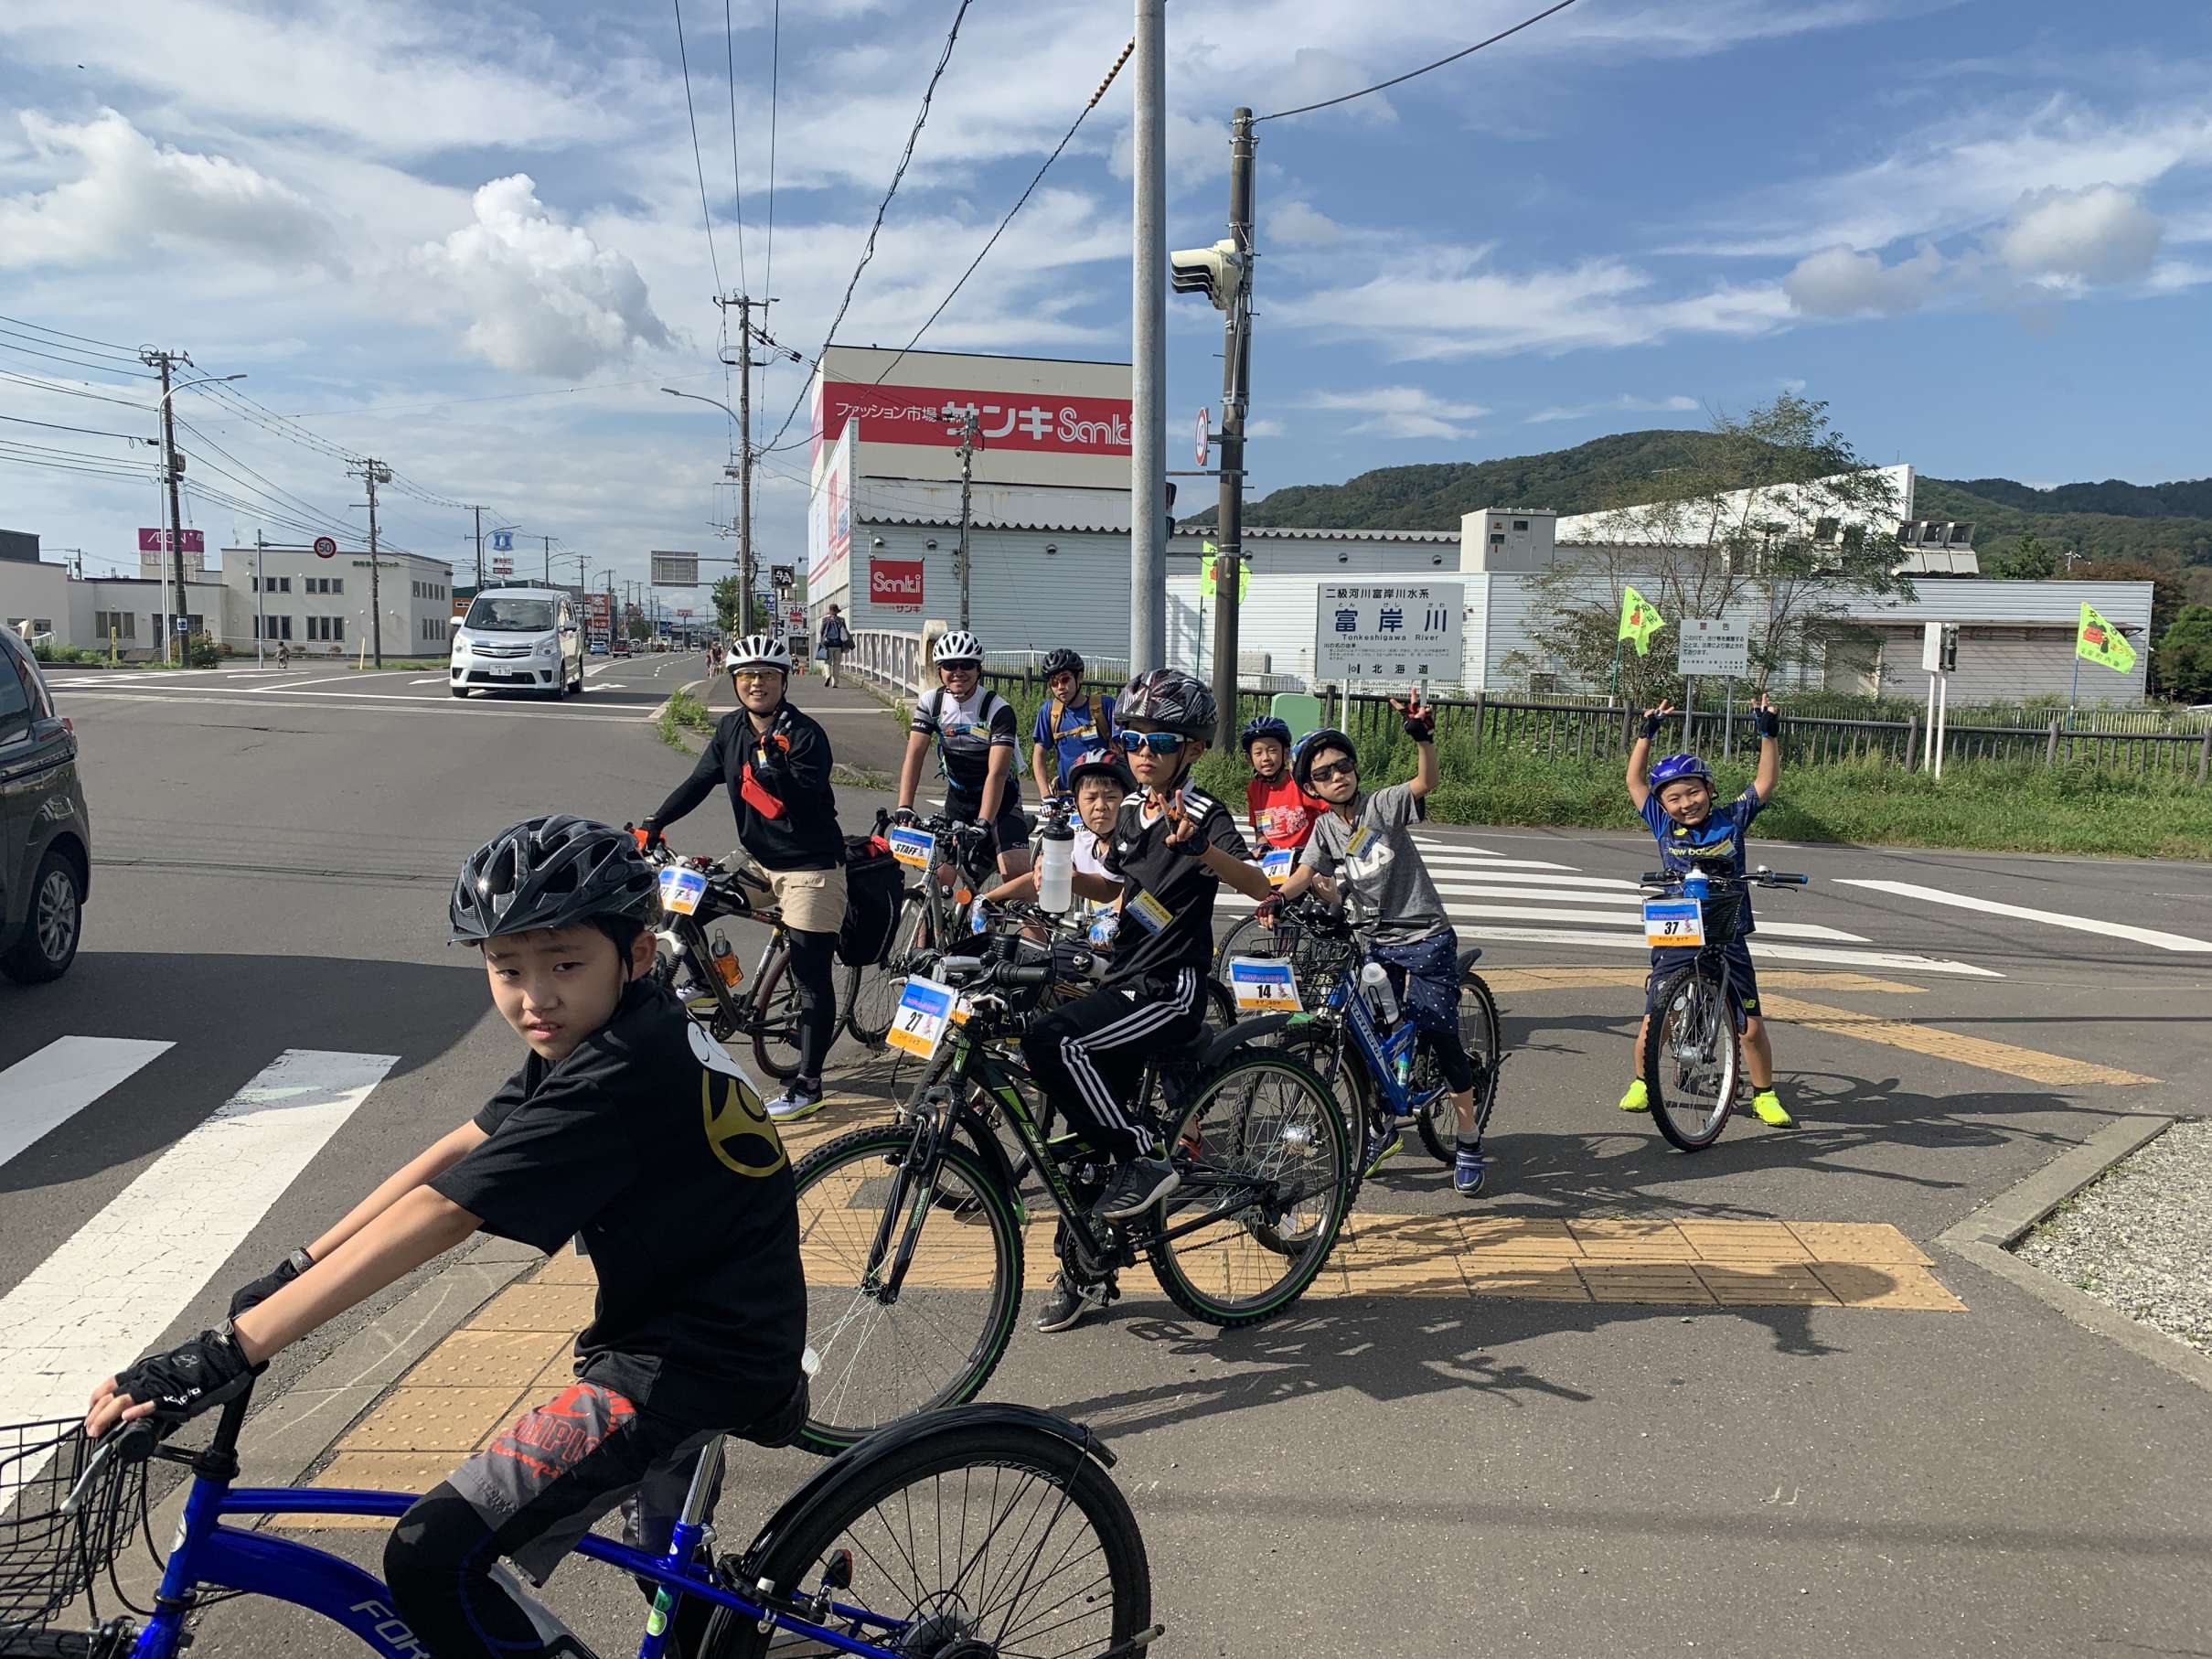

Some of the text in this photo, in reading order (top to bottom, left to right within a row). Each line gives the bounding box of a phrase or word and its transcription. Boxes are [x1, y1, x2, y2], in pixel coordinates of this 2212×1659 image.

[318, 542, 331, 552] 50
[872, 571, 921, 594] Sanki
[1326, 588, 1430, 599] 二級河川富岸川水系
[1335, 608, 1448, 633] 富岸川
[1342, 634, 1407, 642] Tonkeshigawa
[1373, 663, 1429, 675] 北海道
[894, 843, 919, 856] STAFF
[1668, 846, 1687, 857] new
[1663, 921, 1680, 936] 37
[1256, 984, 1272, 999] 14
[904, 1011, 924, 1033] 27
